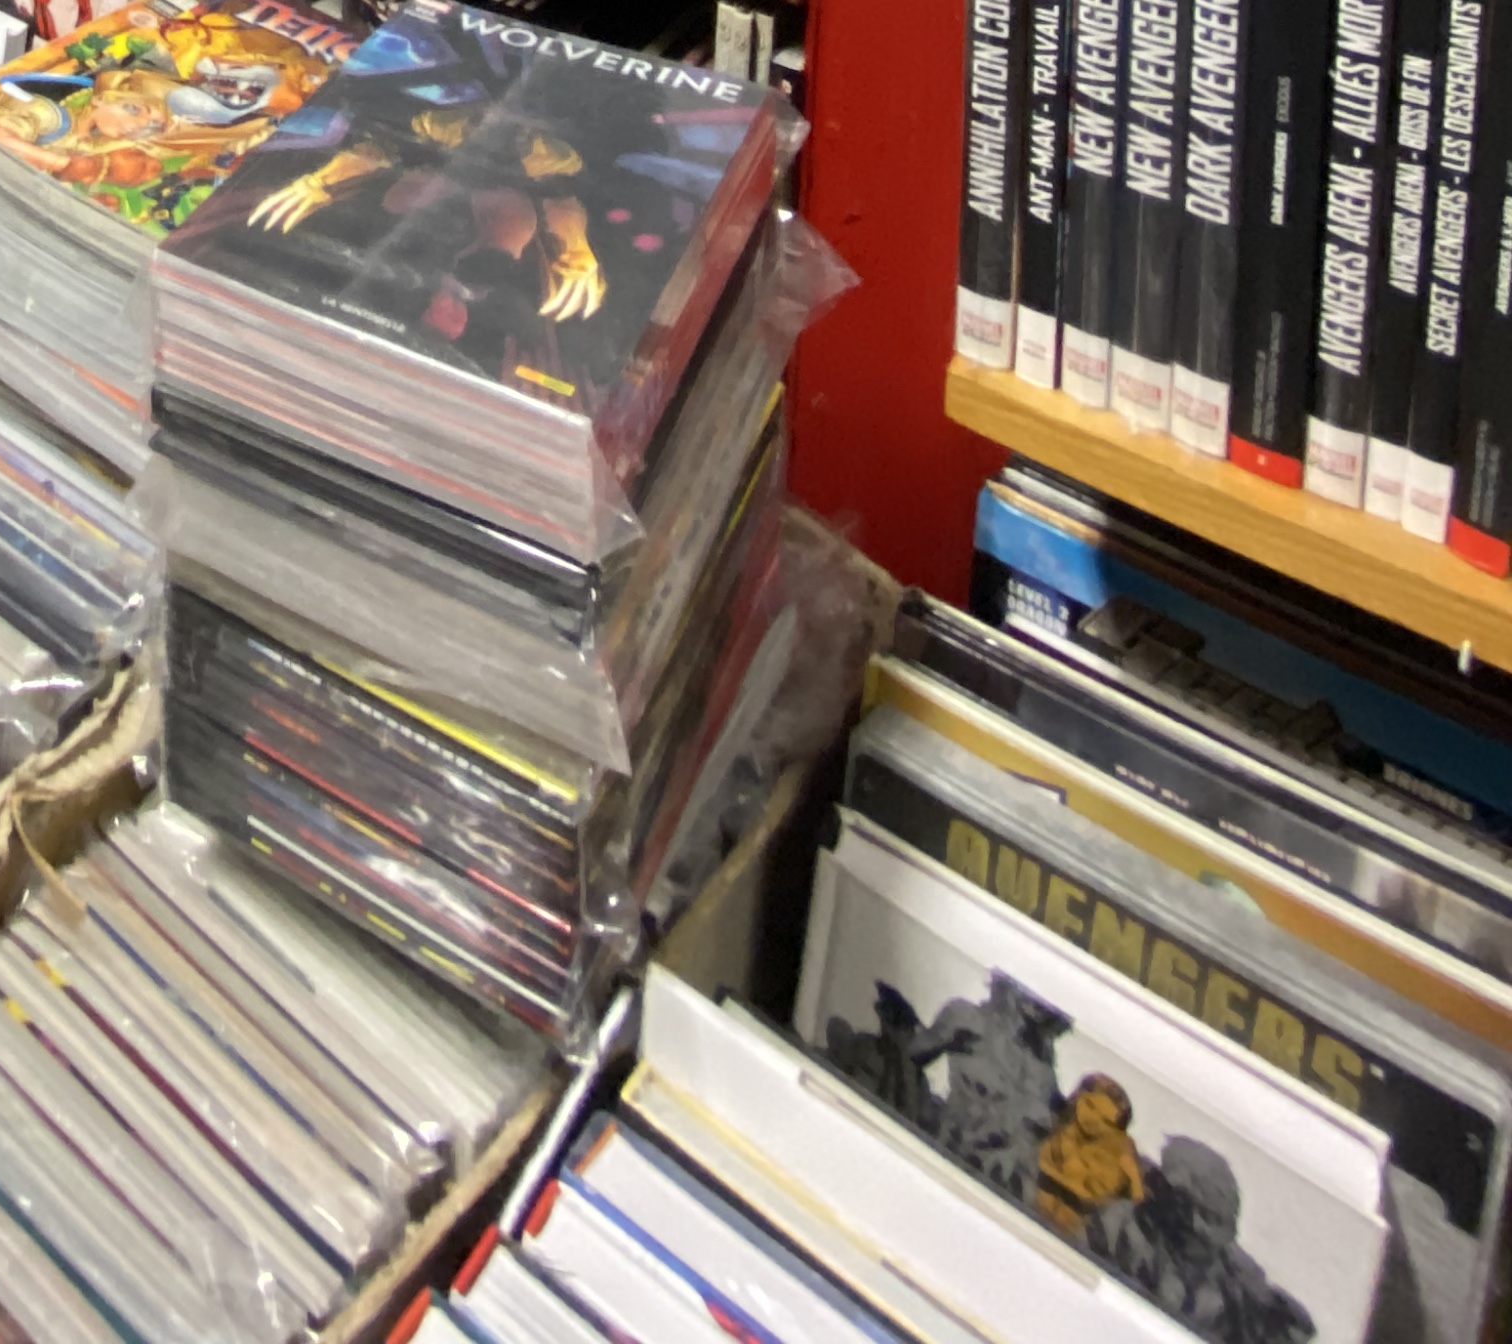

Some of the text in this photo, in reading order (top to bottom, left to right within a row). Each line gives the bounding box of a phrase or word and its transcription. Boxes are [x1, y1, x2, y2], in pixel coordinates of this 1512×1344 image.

[459, 10, 747, 104] WOLVERINE
[1033, 4, 1060, 96] TRAVAIL
[967, 41, 1010, 222] ANNIHILATION
[1027, 114, 1056, 224] ANT-MAN
[1073, 113, 1115, 179] NEW
[1125, 124, 1173, 201] NEW
[1185, 131, 1235, 226] DARK
[1324, 159, 1374, 247] ARENA
[1318, 242, 1370, 377] AVENGERS
[1426, 181, 1469, 359] SECRET AVENGERS
[945, 816, 1366, 1112] AVENGERS
